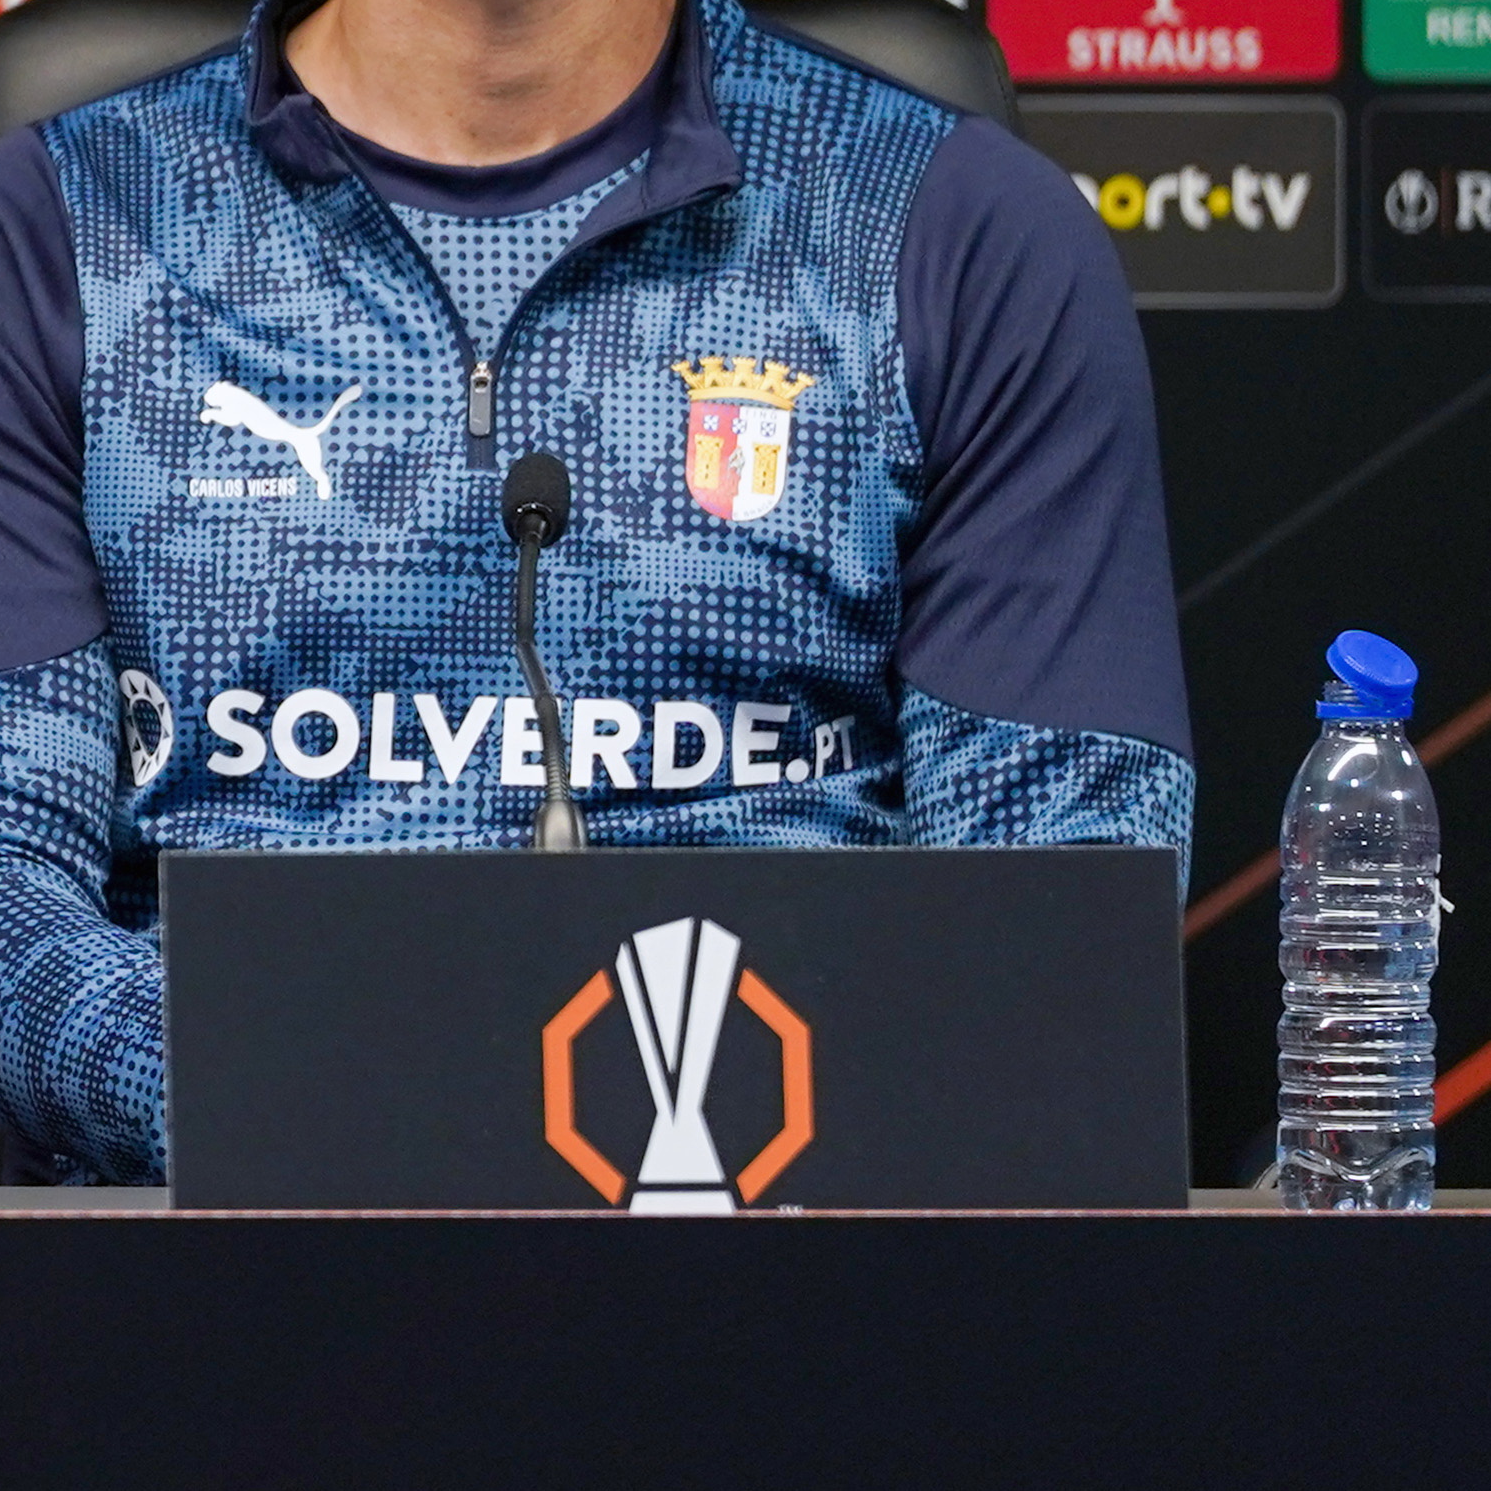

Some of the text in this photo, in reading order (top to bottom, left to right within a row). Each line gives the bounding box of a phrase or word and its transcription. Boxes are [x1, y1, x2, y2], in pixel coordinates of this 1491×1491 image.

[1067, 29, 1262, 70] STRAUSS
[189, 476, 298, 498] CARLOS VICENS
